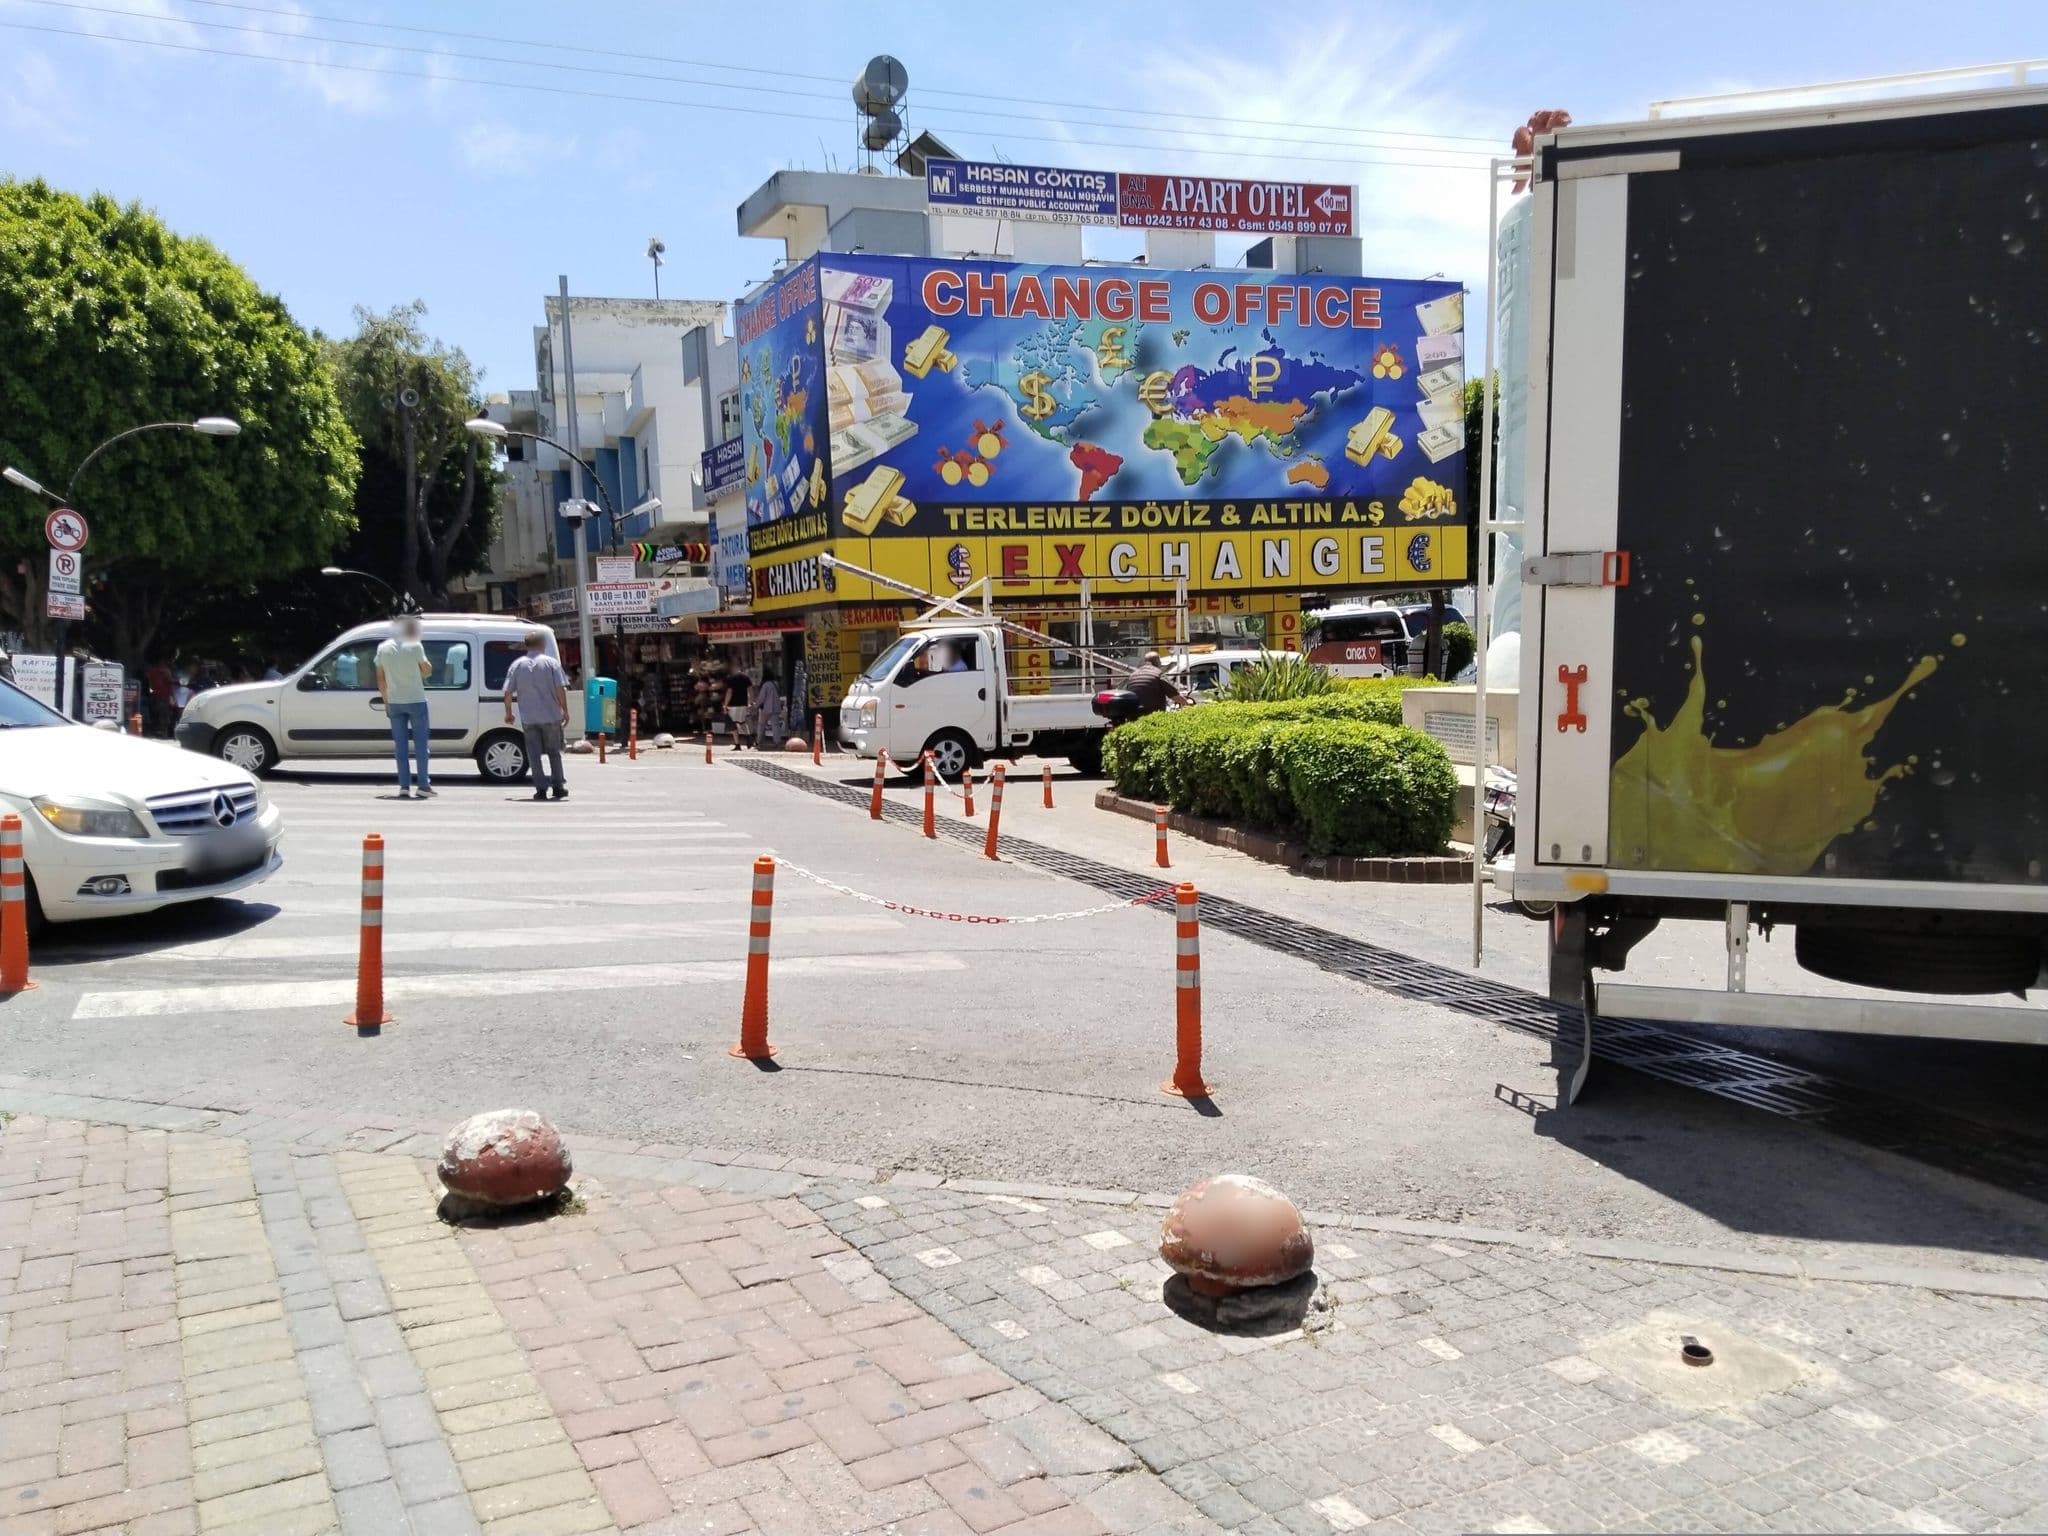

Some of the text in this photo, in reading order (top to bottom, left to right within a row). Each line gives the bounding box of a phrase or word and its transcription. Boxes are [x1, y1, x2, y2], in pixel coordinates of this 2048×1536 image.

[967, 165, 1106, 193] HASAN GÖKTAŞ
[959, 183, 1115, 203] SERBEST MUHASEBECİ MALİ MÜŞAVİR
[1120, 193, 1154, 209] ÜNAL
[1161, 178, 1309, 217] APART OTEL
[976, 196, 1099, 212] CERTIFIED PUBLIC ACCOUNTANT
[1320, 196, 1346, 210] 100 mt
[962, 208, 984, 217] 0242
[1052, 213, 1074, 222] 0537
[1076, 214, 1091, 224] 765
[1094, 215, 1105, 224] 02
[1107, 216, 1115, 225] 15
[1122, 214, 1347, 234] Tel: 0242 517 43 08 Gsm: 0549 899 07 07
[739, 264, 816, 346] CHANGE OFFICE
[922, 270, 1382, 330] CHANGE OFFICE
[717, 439, 742, 464] HASAN
[944, 500, 1384, 530] TERLEMEZ DÖVİZ & ALTIN A.Ş
[722, 533, 744, 558] FATURA
[1001, 536, 1385, 586] EXCHANGE
[589, 591, 646, 601] 10.00 01.00
[848, 607, 899, 625] EXCHANGE
[808, 652, 840, 662] CHANGE
[1346, 647, 1367, 660] anex
[811, 662, 840, 671] OFFICE
[809, 674, 841, 684] ОБМЕН
